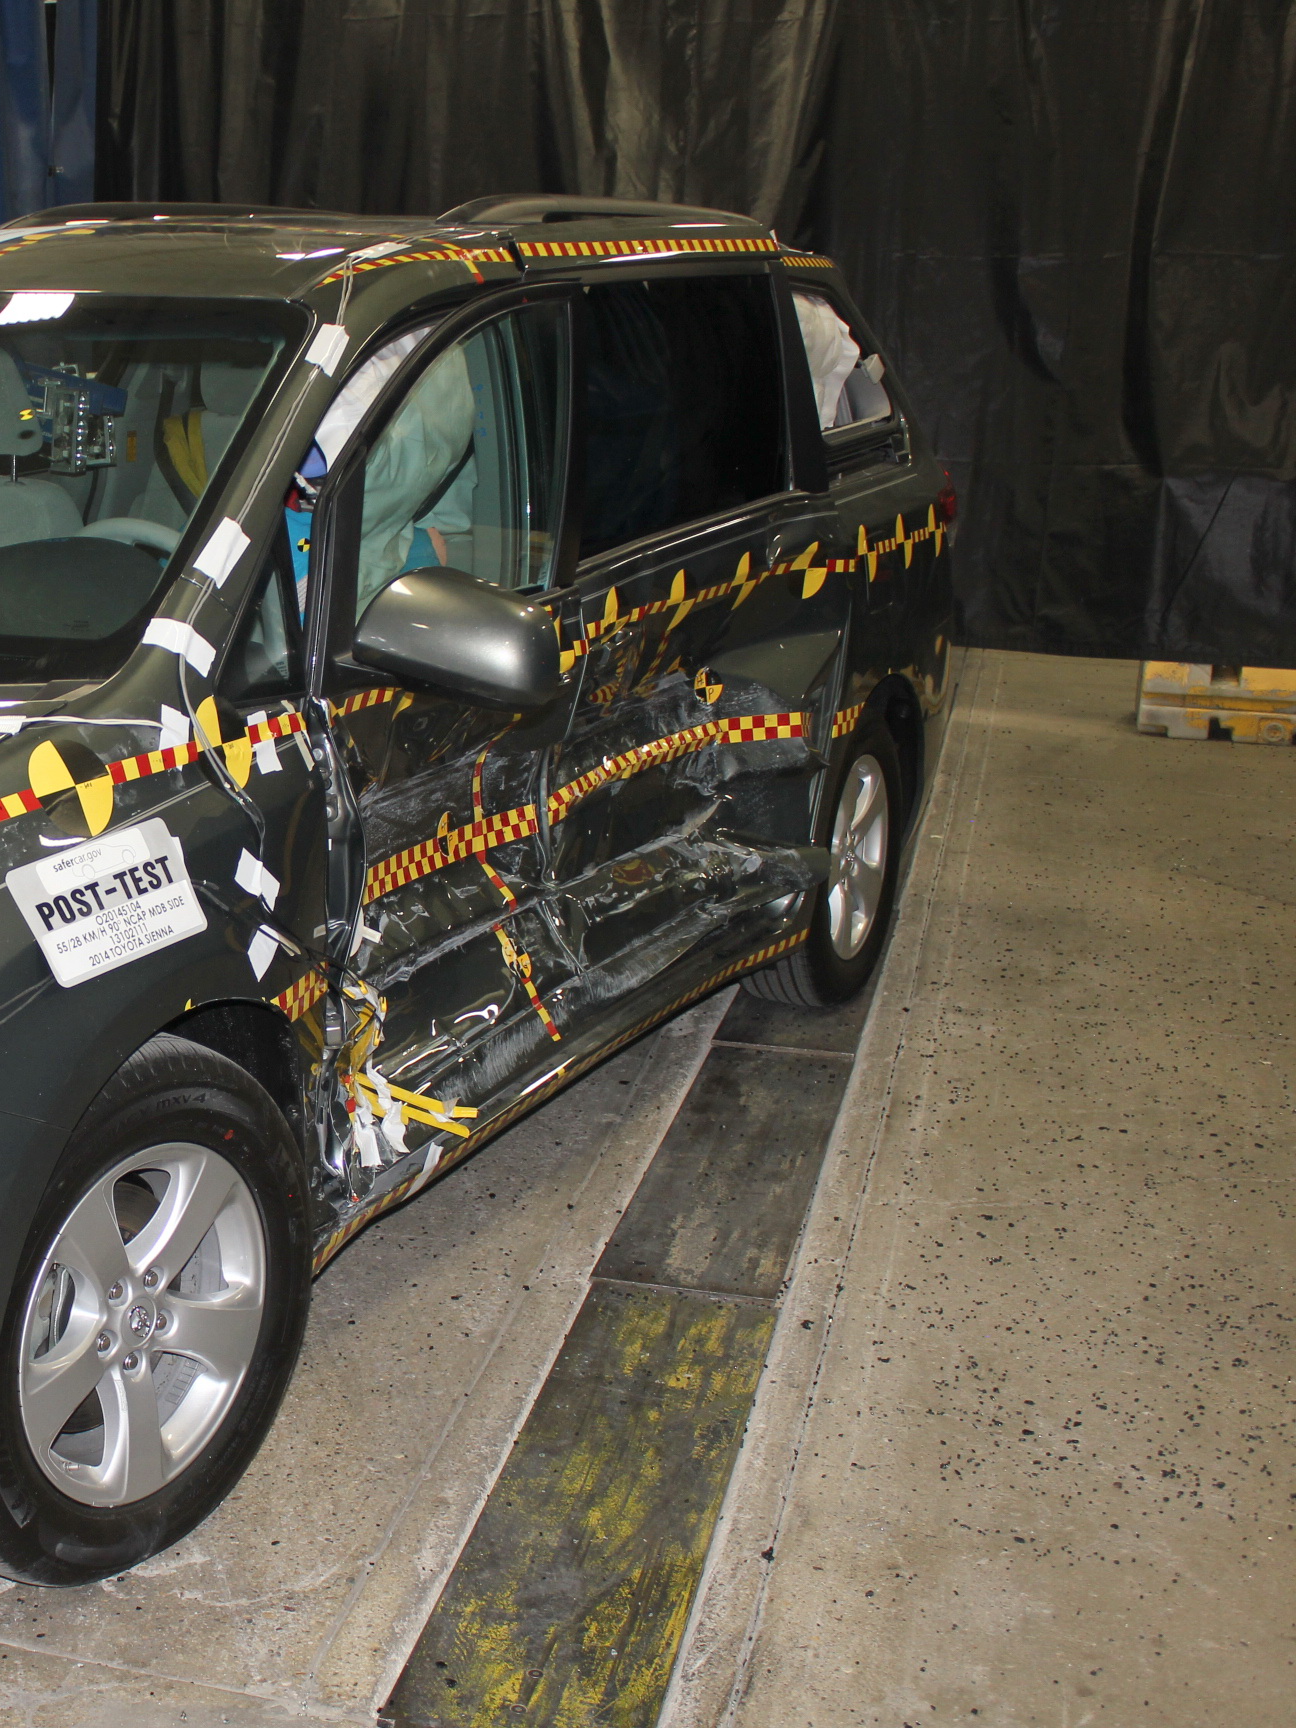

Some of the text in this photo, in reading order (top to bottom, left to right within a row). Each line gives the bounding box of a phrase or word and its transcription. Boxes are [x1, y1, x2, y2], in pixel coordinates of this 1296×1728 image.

[53, 848, 102, 873] safercar.gov
[35, 855, 174, 931] POST-TEST
[56, 936, 83, 954] 55/28
[83, 927, 107, 943] KM/H
[124, 911, 147, 927] NCAP
[149, 903, 168, 918] MDB
[169, 895, 185, 911] SIDE
[109, 923, 149, 945] 13102111
[89, 925, 174, 966] 2014 TOYOTA SIENNA
